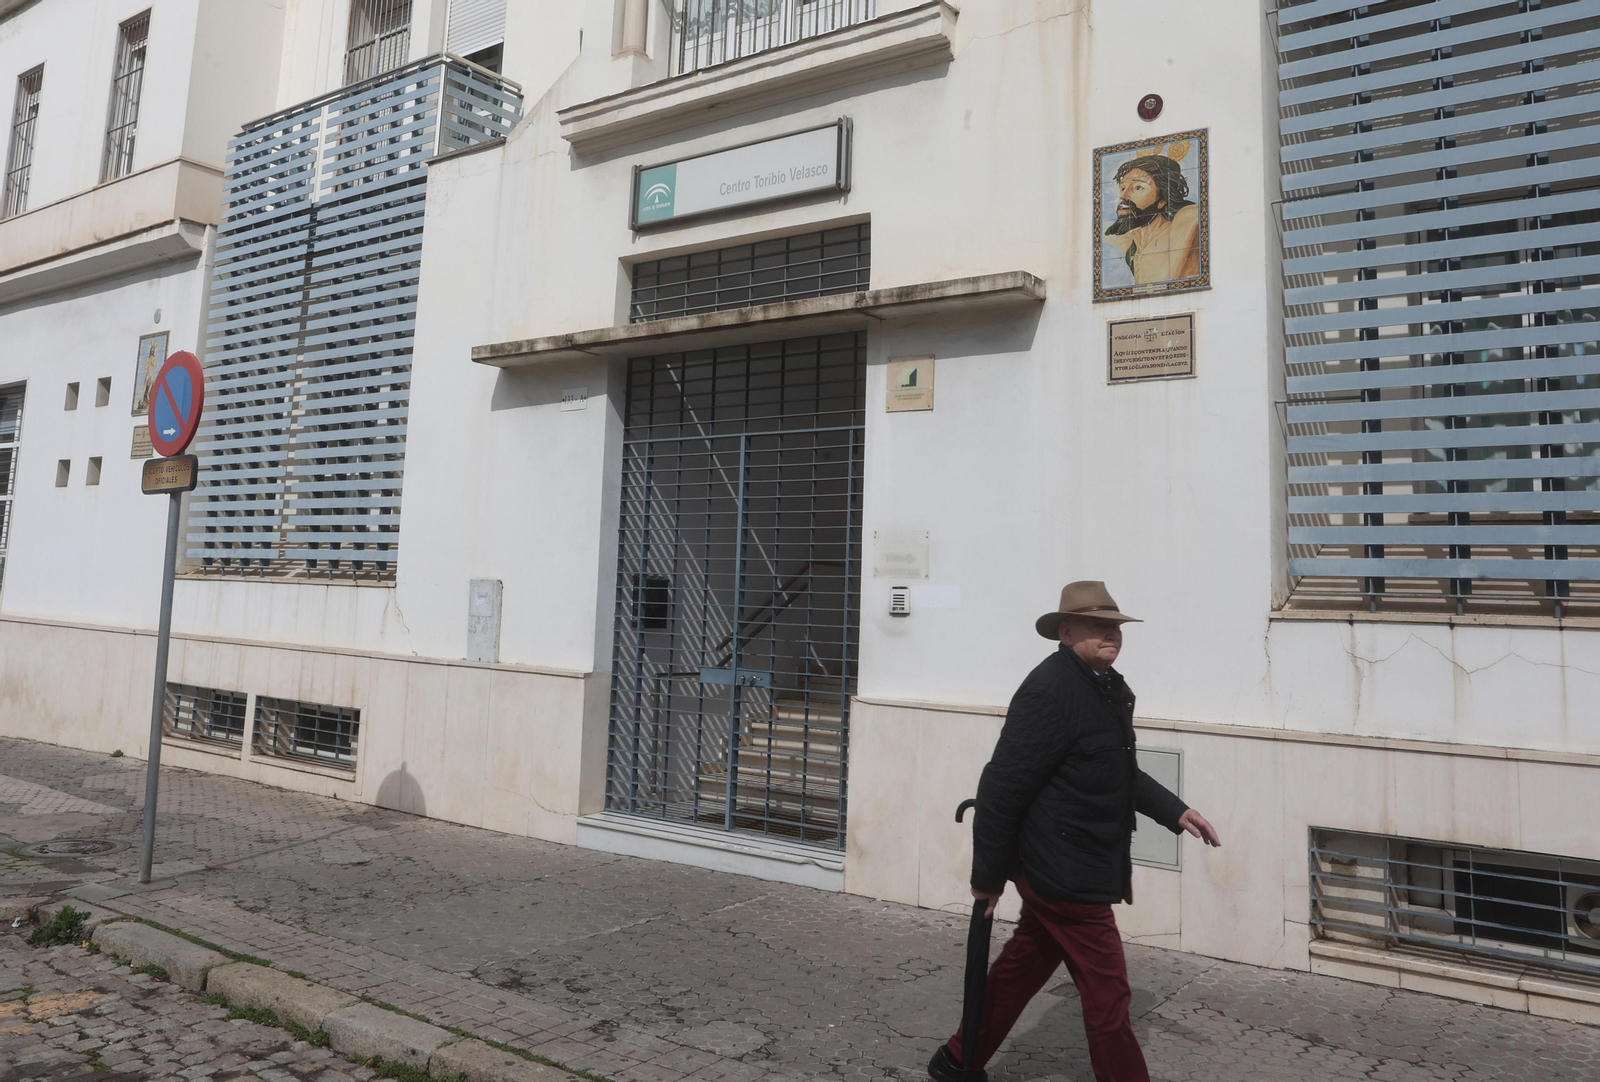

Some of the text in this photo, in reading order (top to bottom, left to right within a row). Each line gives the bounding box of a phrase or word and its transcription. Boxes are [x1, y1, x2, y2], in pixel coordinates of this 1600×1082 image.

[719, 164, 828, 196] Centro Toribio Velasco
